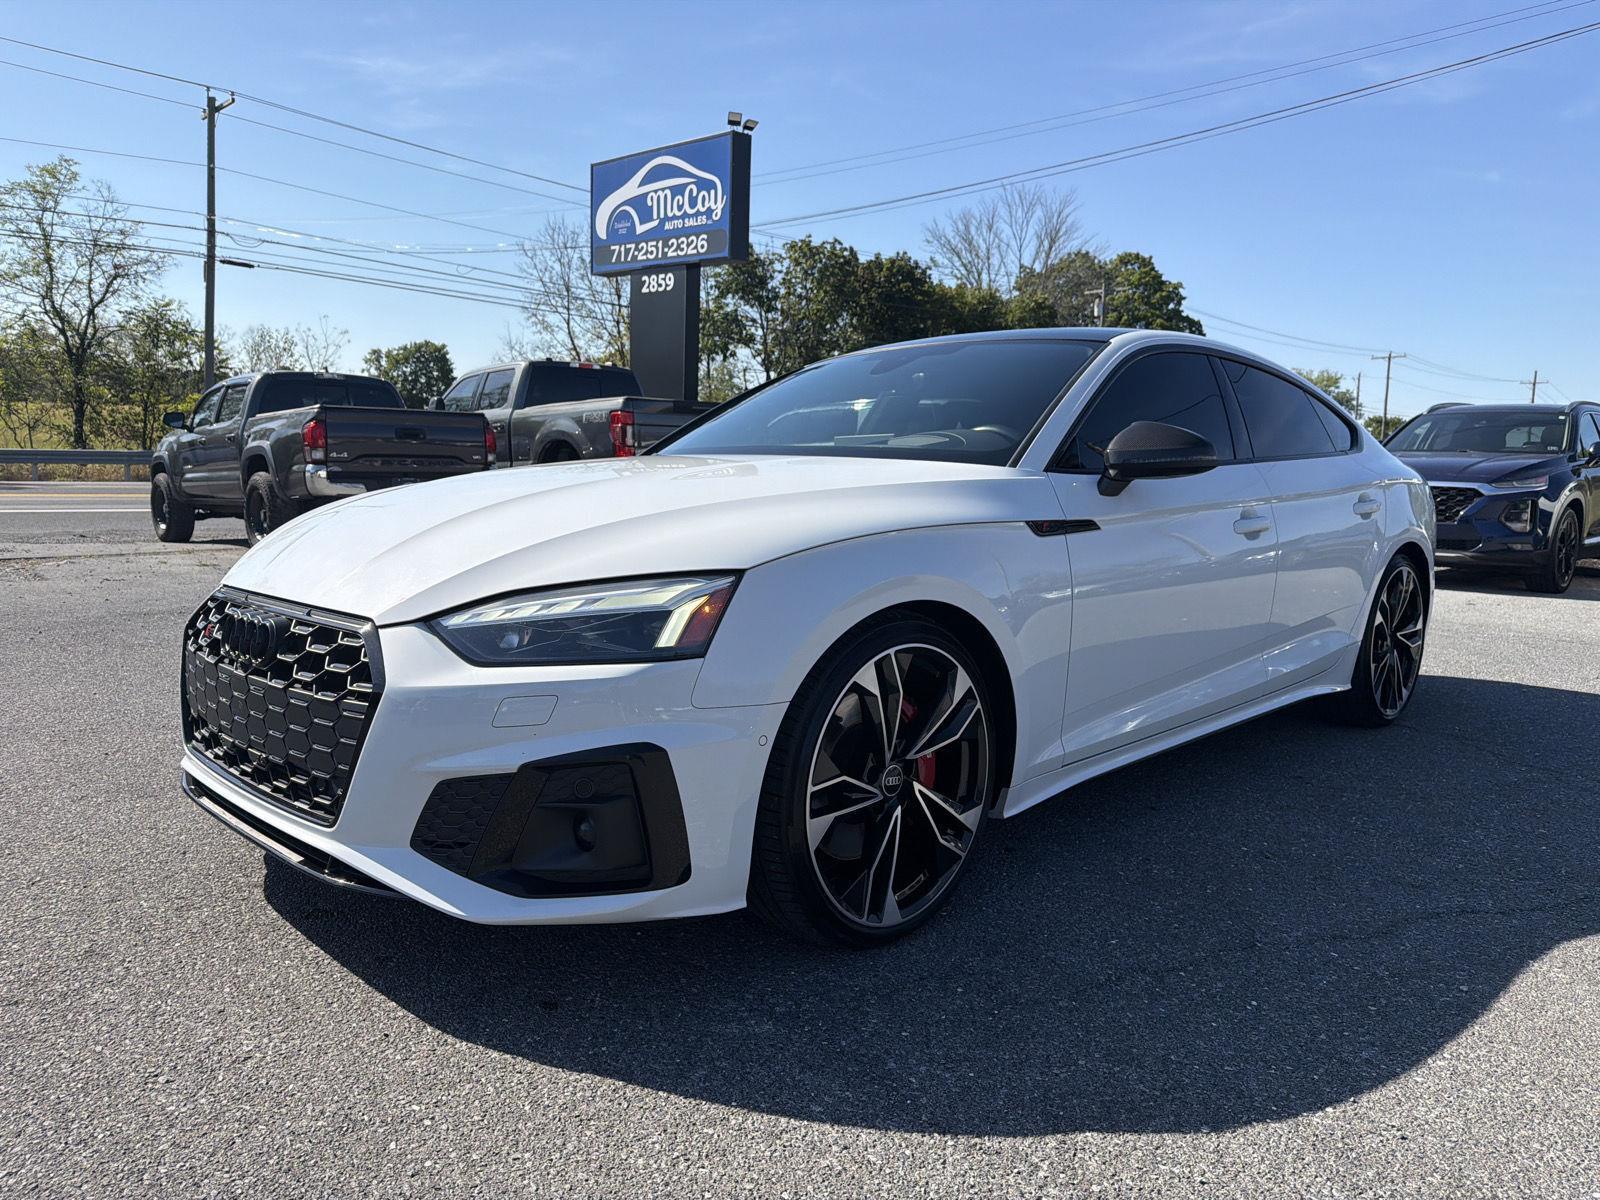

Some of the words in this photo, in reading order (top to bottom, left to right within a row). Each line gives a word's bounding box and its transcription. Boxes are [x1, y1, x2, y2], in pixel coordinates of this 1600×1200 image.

[647, 184, 726, 220] McCoy
[664, 219, 683, 230] AUTO
[684, 215, 707, 227] SALES
[610, 234, 708, 263] 717-251-2326
[641, 272, 675, 293] 2859
